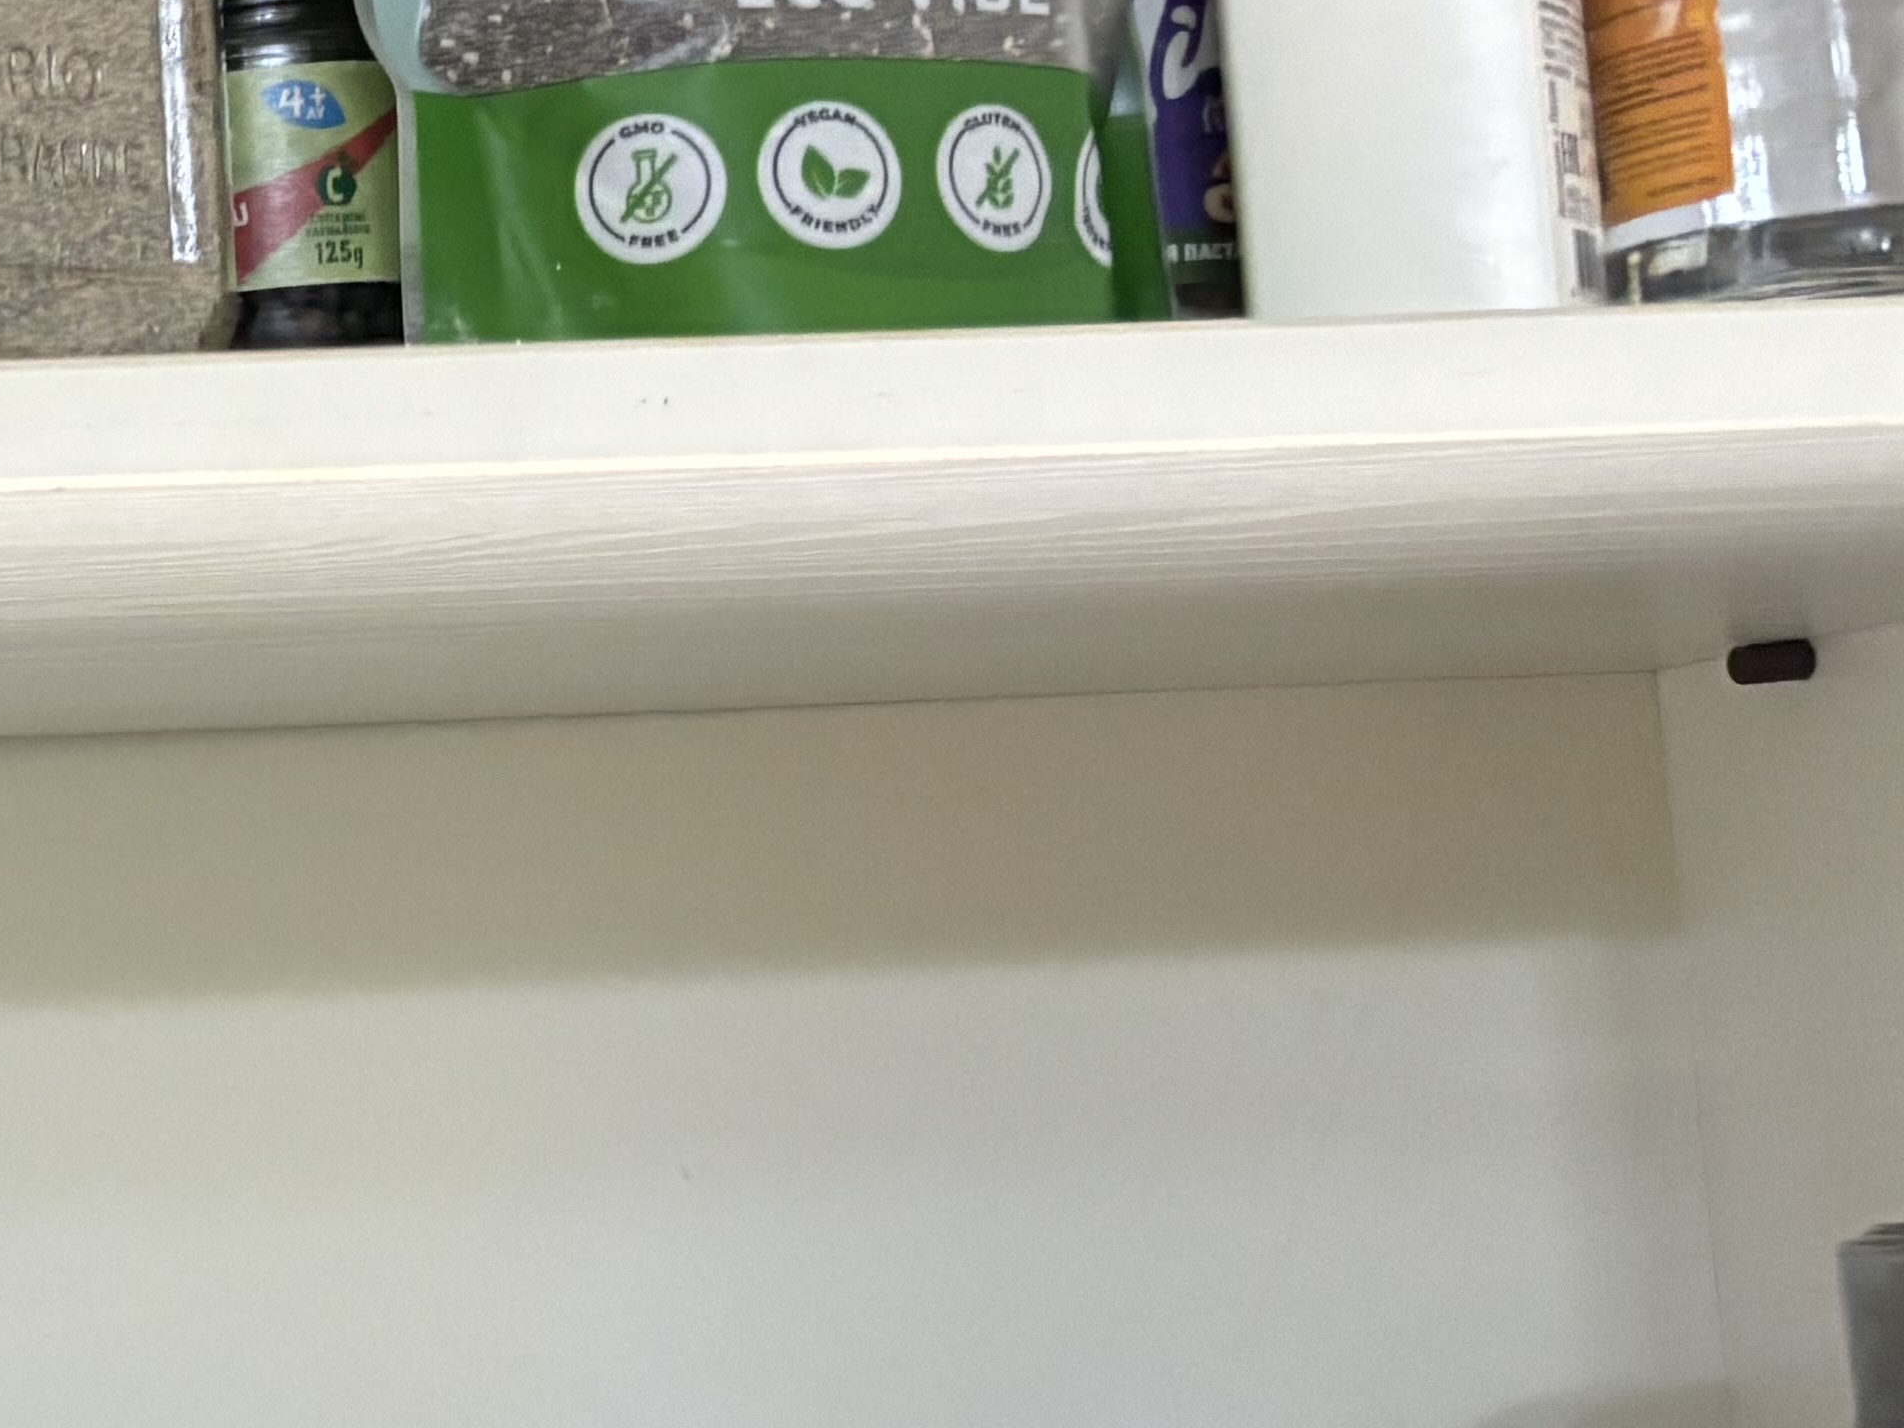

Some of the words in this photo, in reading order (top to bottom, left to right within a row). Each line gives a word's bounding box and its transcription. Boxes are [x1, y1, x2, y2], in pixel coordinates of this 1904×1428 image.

[795, 107, 857, 127] VEGAN
[619, 122, 665, 140] GMO
[791, 203, 879, 233] FRIENDLY
[628, 229, 680, 248] FREE
[315, 240, 364, 269] 125g
